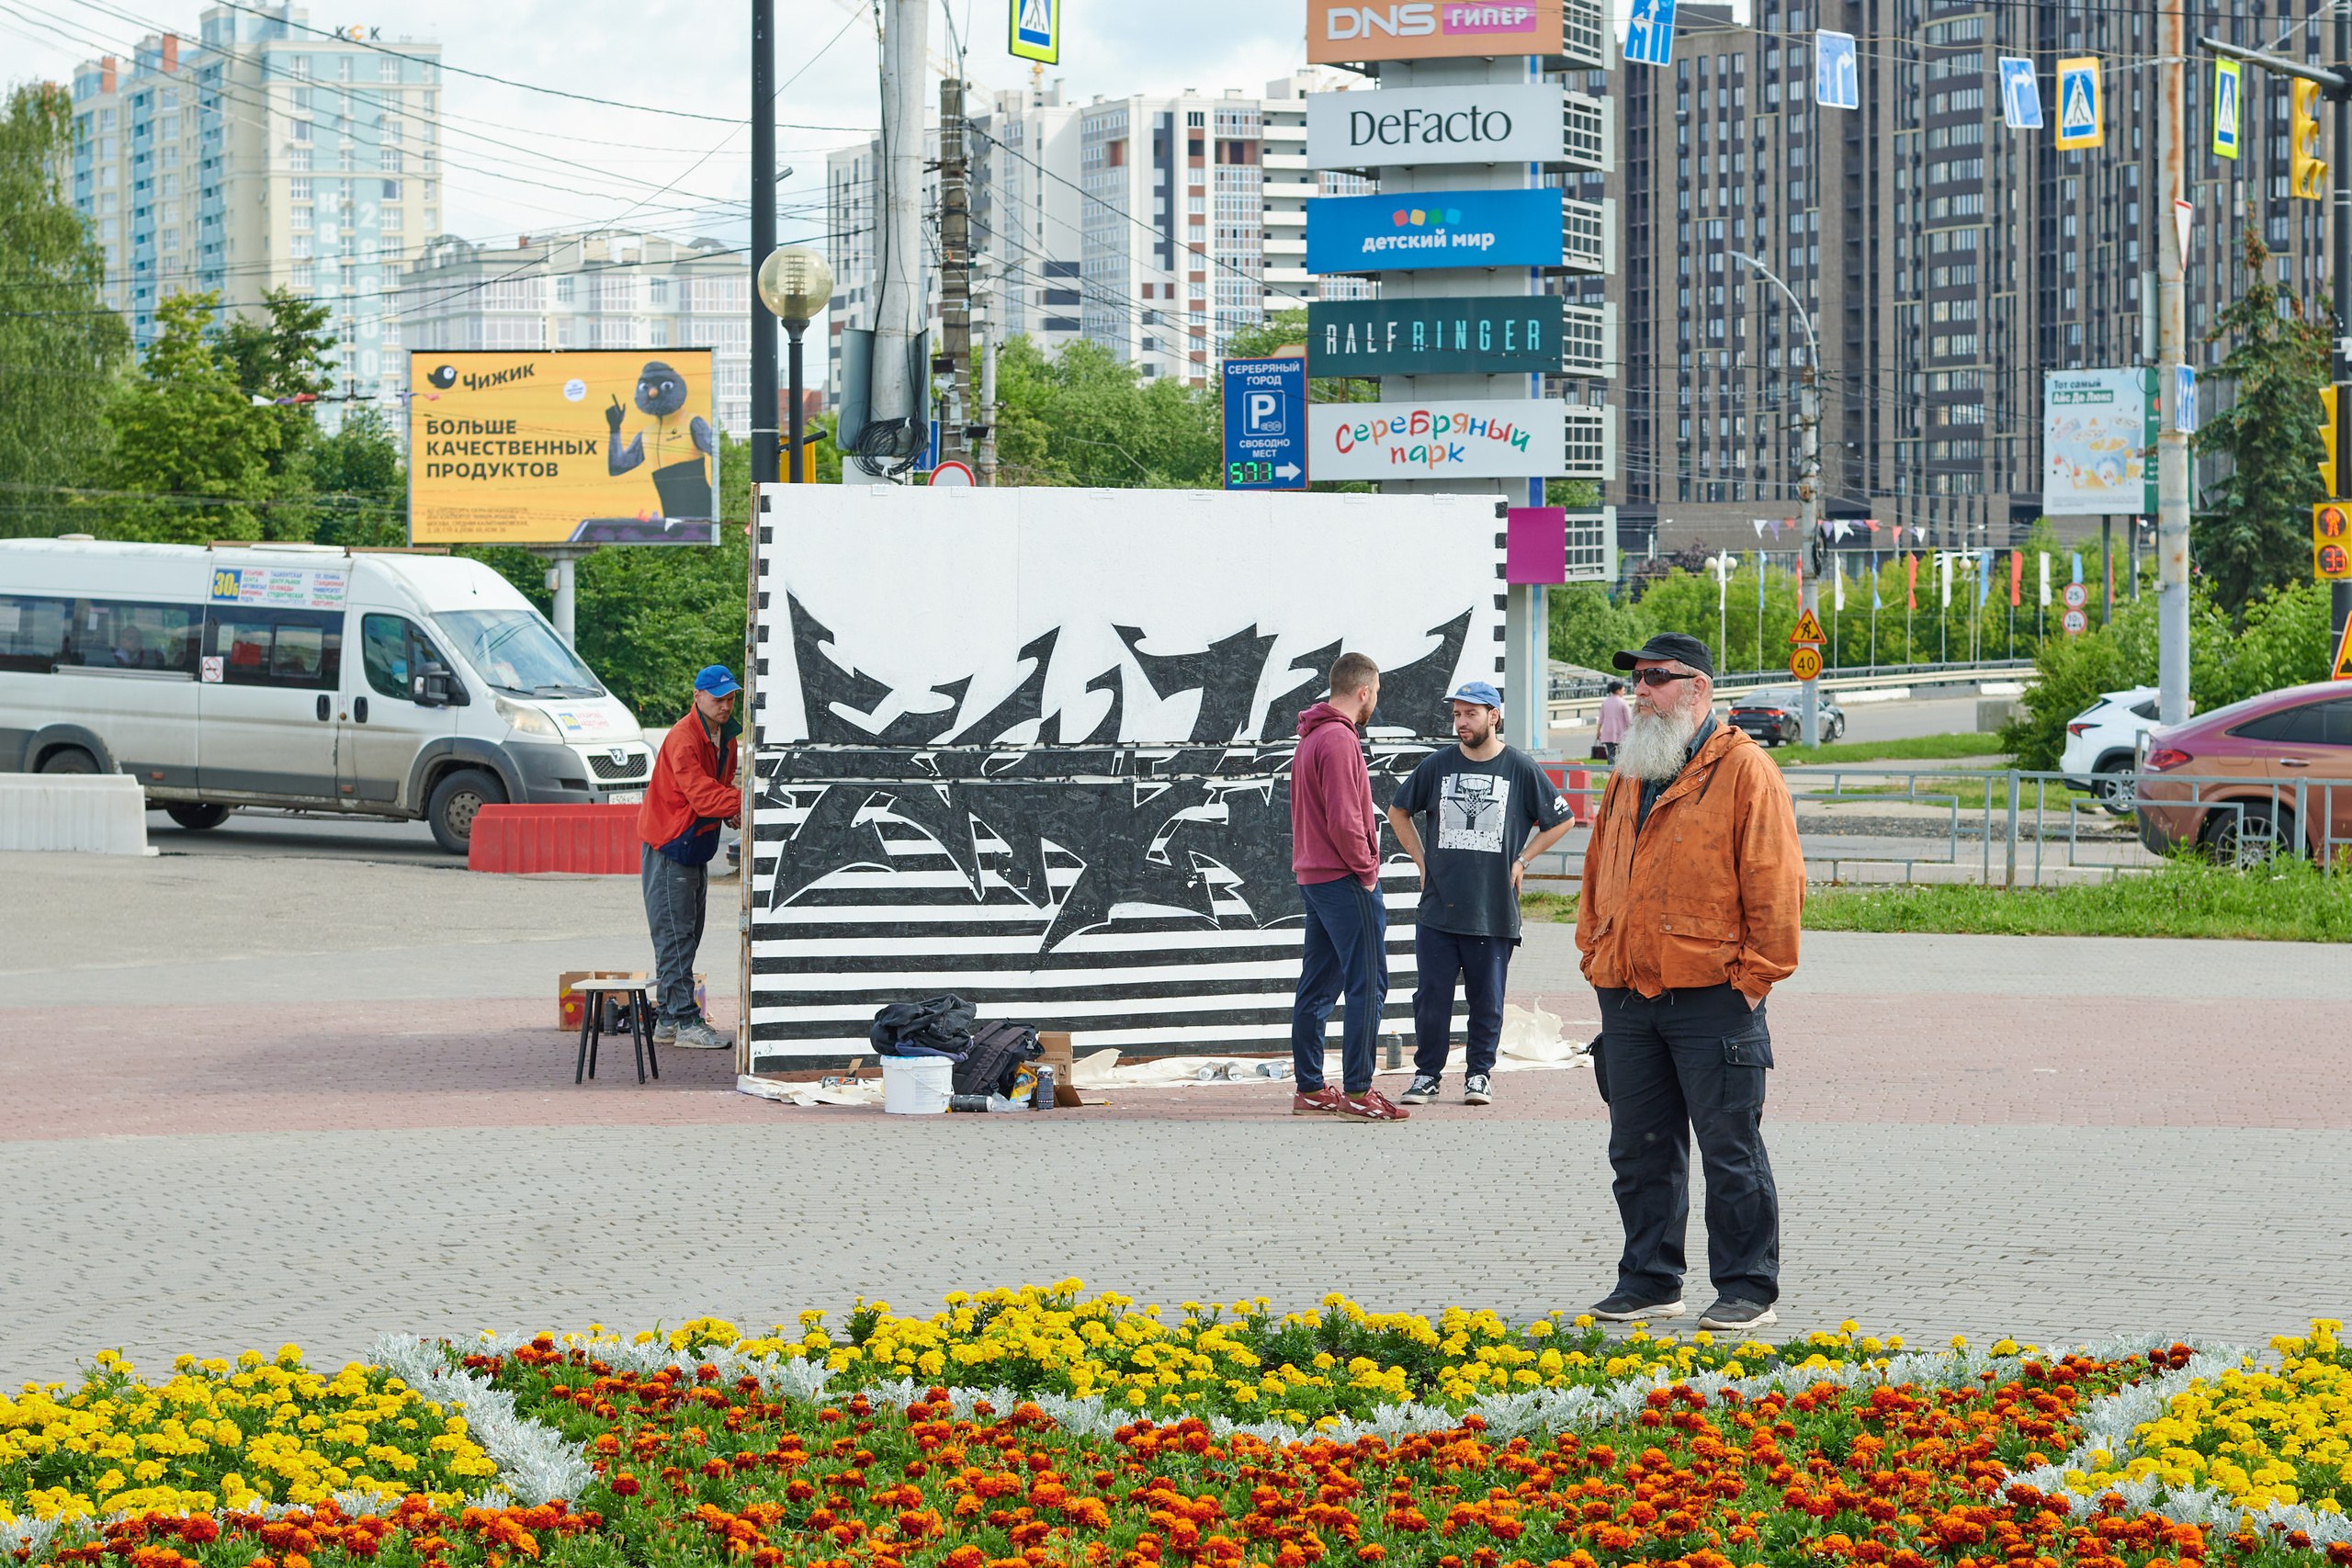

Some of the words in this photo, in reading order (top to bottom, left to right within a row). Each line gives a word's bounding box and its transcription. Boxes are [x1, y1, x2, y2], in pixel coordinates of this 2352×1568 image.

[1327, 4, 1436, 40] DNS
[1452, 6, 1528, 28] ГИПЕР
[1350, 105, 1512, 146] DeFacto
[1362, 229, 1446, 253] детский
[1453, 231, 1495, 251] мир
[1326, 321, 1398, 355] RALF
[1412, 319, 1541, 352] RINGER
[462, 363, 536, 391] Чижик
[1227, 361, 1300, 374] СЕРЕБРЯНЫЙ
[1247, 376, 1282, 386] ГОРОД
[2054, 379, 2068, 389] Тот
[2070, 378, 2101, 389] самый
[426, 420, 516, 434] БОЛЬШЕ
[426, 440, 598, 456] КАЧЕСТВЕННЫХ
[1238, 438, 1290, 448] СВОБОДНО
[1252, 449, 1277, 457] МЕСТ
[1390, 442, 1465, 470] парк
[426, 462, 559, 480] ПРОДУКТОВ
[1229, 462, 1272, 484] 571
[2324, 547, 2346, 572] 33
[1797, 657, 1815, 671] 40
